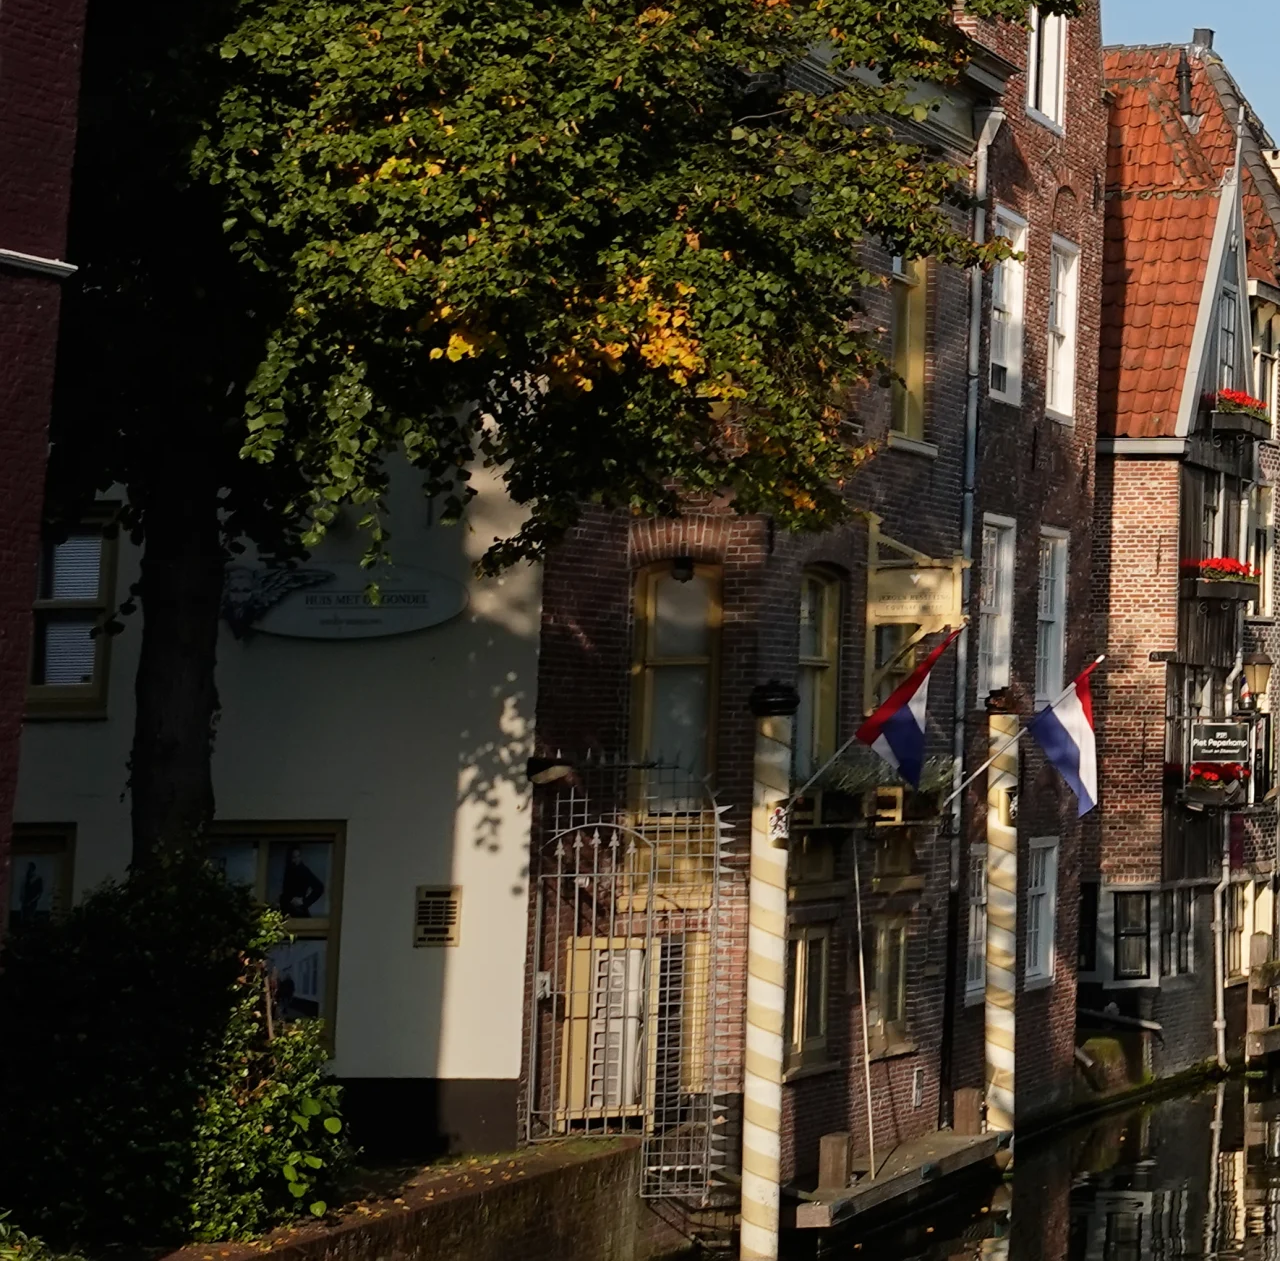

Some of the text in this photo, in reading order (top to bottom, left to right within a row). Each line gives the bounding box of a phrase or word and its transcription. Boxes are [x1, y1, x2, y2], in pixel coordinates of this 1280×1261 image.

[305, 595, 332, 605] HUIS
[335, 594, 360, 605] MET
[1193, 738, 1248, 748] Piet Peperkamp
